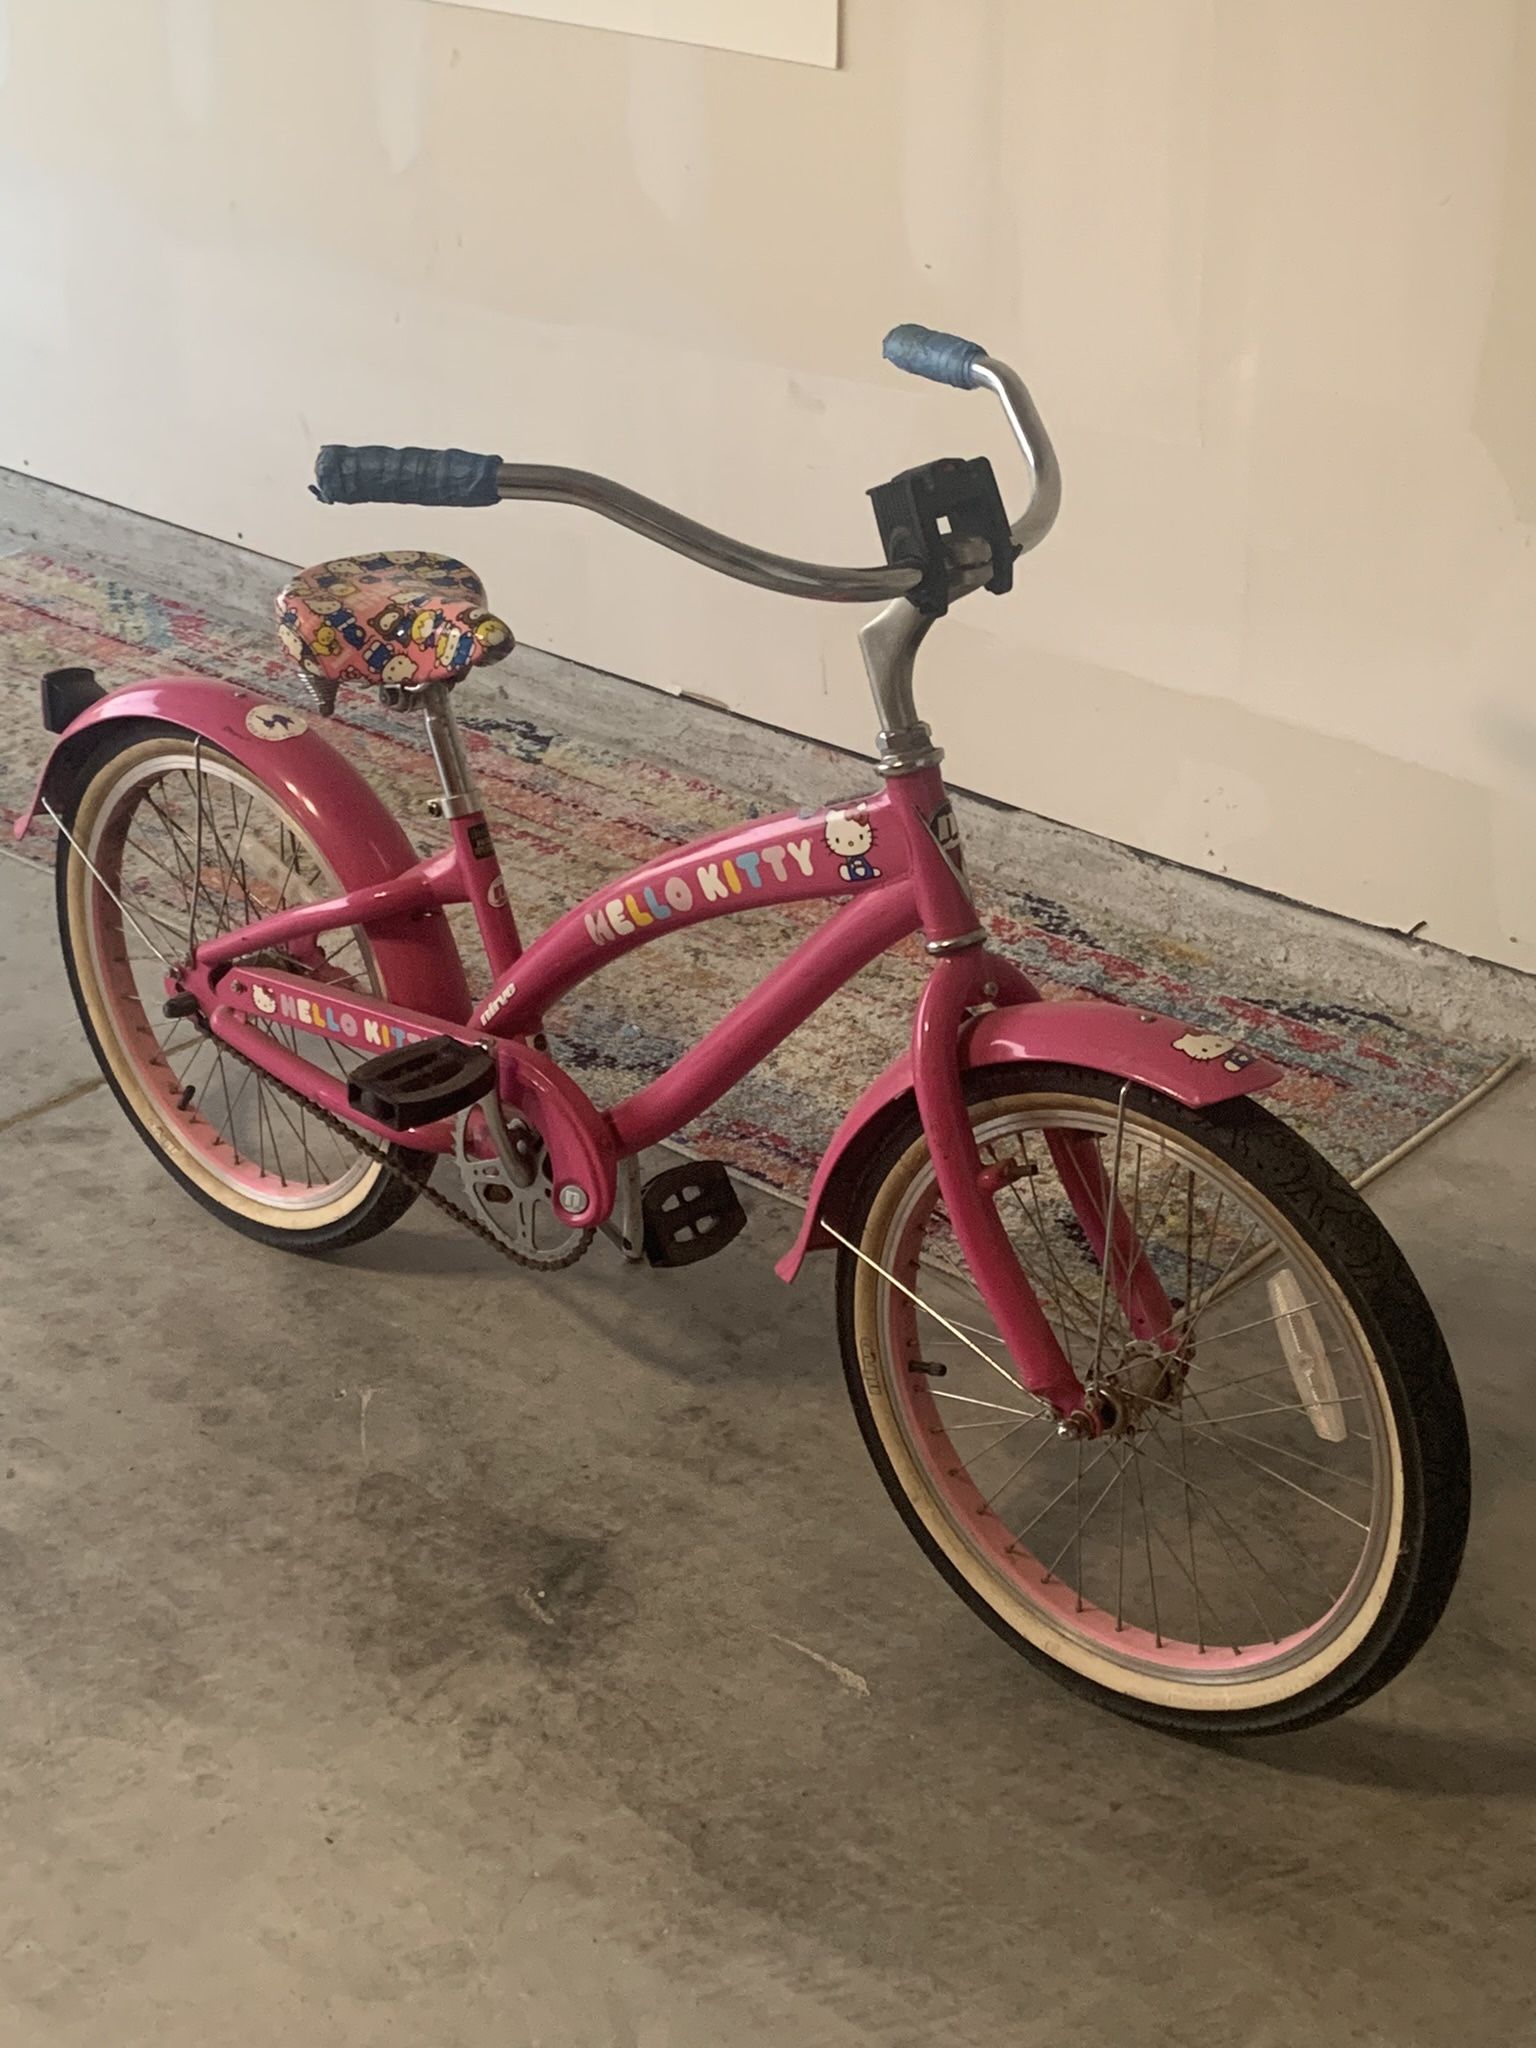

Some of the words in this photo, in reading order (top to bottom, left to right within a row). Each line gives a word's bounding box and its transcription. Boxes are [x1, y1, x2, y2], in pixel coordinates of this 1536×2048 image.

[584, 876, 694, 946] HELLO
[696, 838, 814, 902] KITTY
[280, 993, 359, 1038] HELLO
[363, 1018, 428, 1050] KIT
